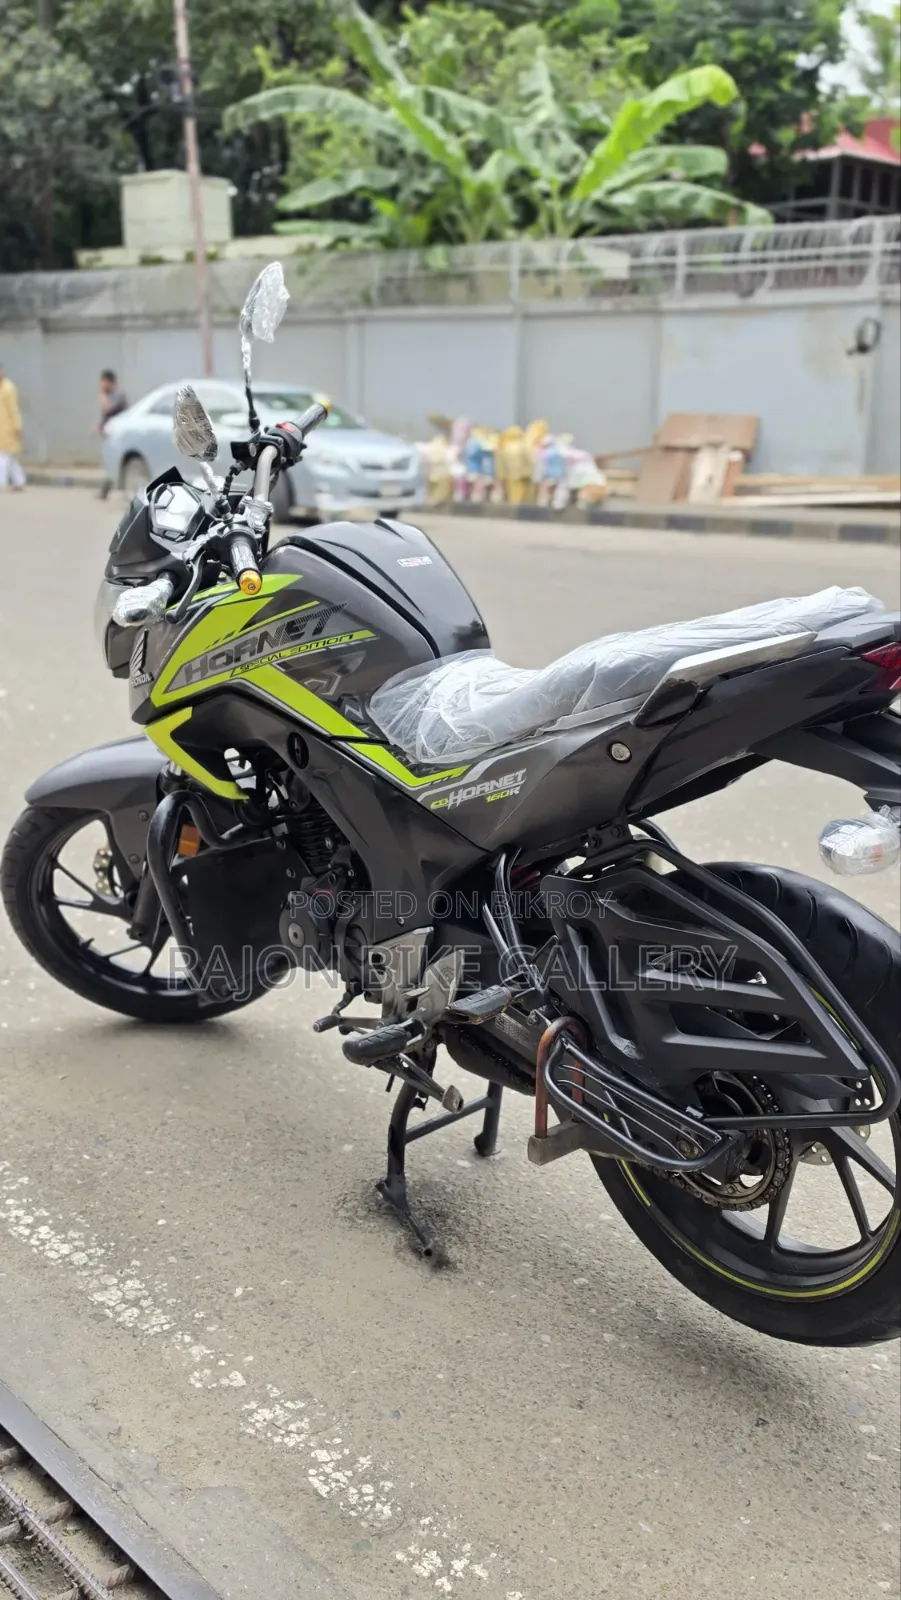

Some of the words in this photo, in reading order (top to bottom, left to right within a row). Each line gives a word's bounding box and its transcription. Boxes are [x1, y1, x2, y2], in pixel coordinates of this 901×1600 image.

[184, 602, 347, 684] HORNET
[239, 653, 284, 673] SPECIAL
[290, 633, 354, 654] EDITION
[130, 671, 153, 687] HONDA
[447, 768, 527, 810] HORNET
[486, 785, 520, 803] 160R
